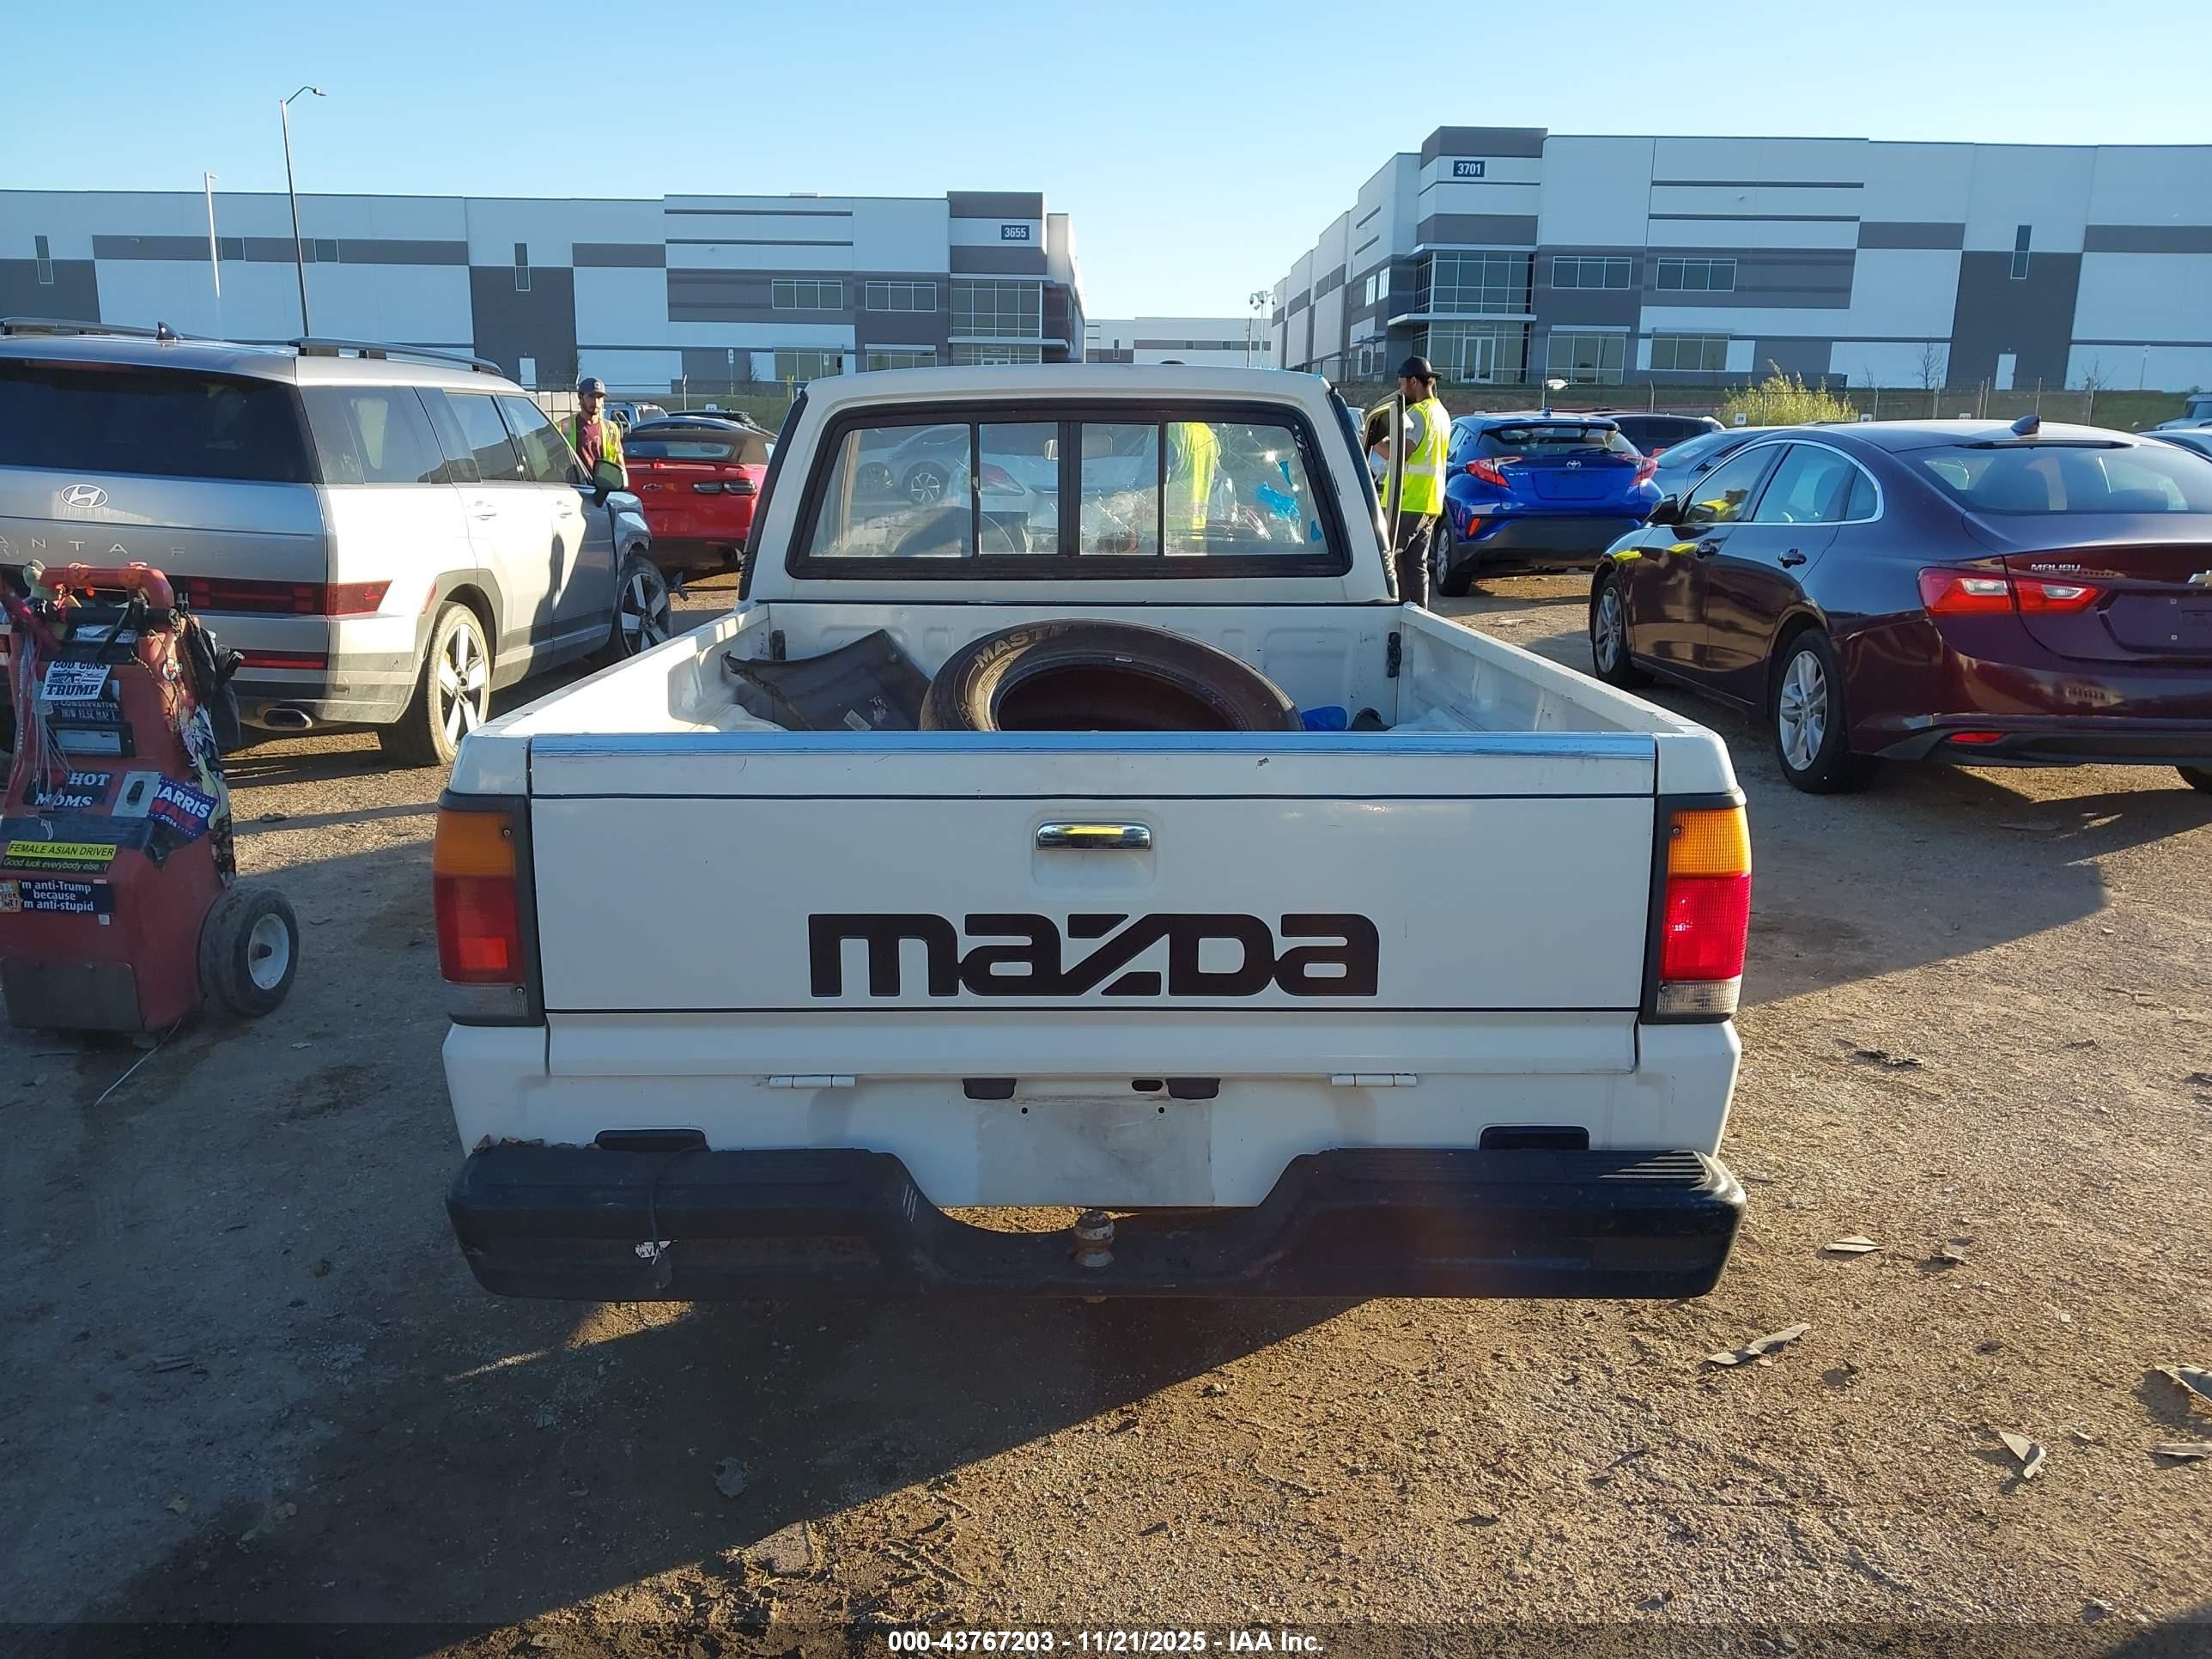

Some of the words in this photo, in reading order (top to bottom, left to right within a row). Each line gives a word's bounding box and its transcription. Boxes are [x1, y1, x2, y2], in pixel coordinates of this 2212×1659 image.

[1457, 163, 1481, 174] 3701
[1005, 227, 1027, 238] 3655
[0, 535, 129, 555] ANTA
[68, 773, 110, 787] HOT
[34, 793, 93, 808] MOMS
[160, 814, 178, 828] 2024
[9, 843, 47, 854] FEMALE
[48, 845, 79, 856] ASIAN
[79, 847, 115, 857] DRIVER
[3, 858, 24, 867] Good
[24, 859, 42, 868] luck
[41, 860, 82, 872] everybody
[82, 862, 100, 871] else
[18, 879, 32, 890] 'm
[33, 879, 92, 894] anti-Trump
[33, 889, 76, 901] because
[21, 898, 34, 909] 'm
[36, 899, 94, 914] anti-stupid
